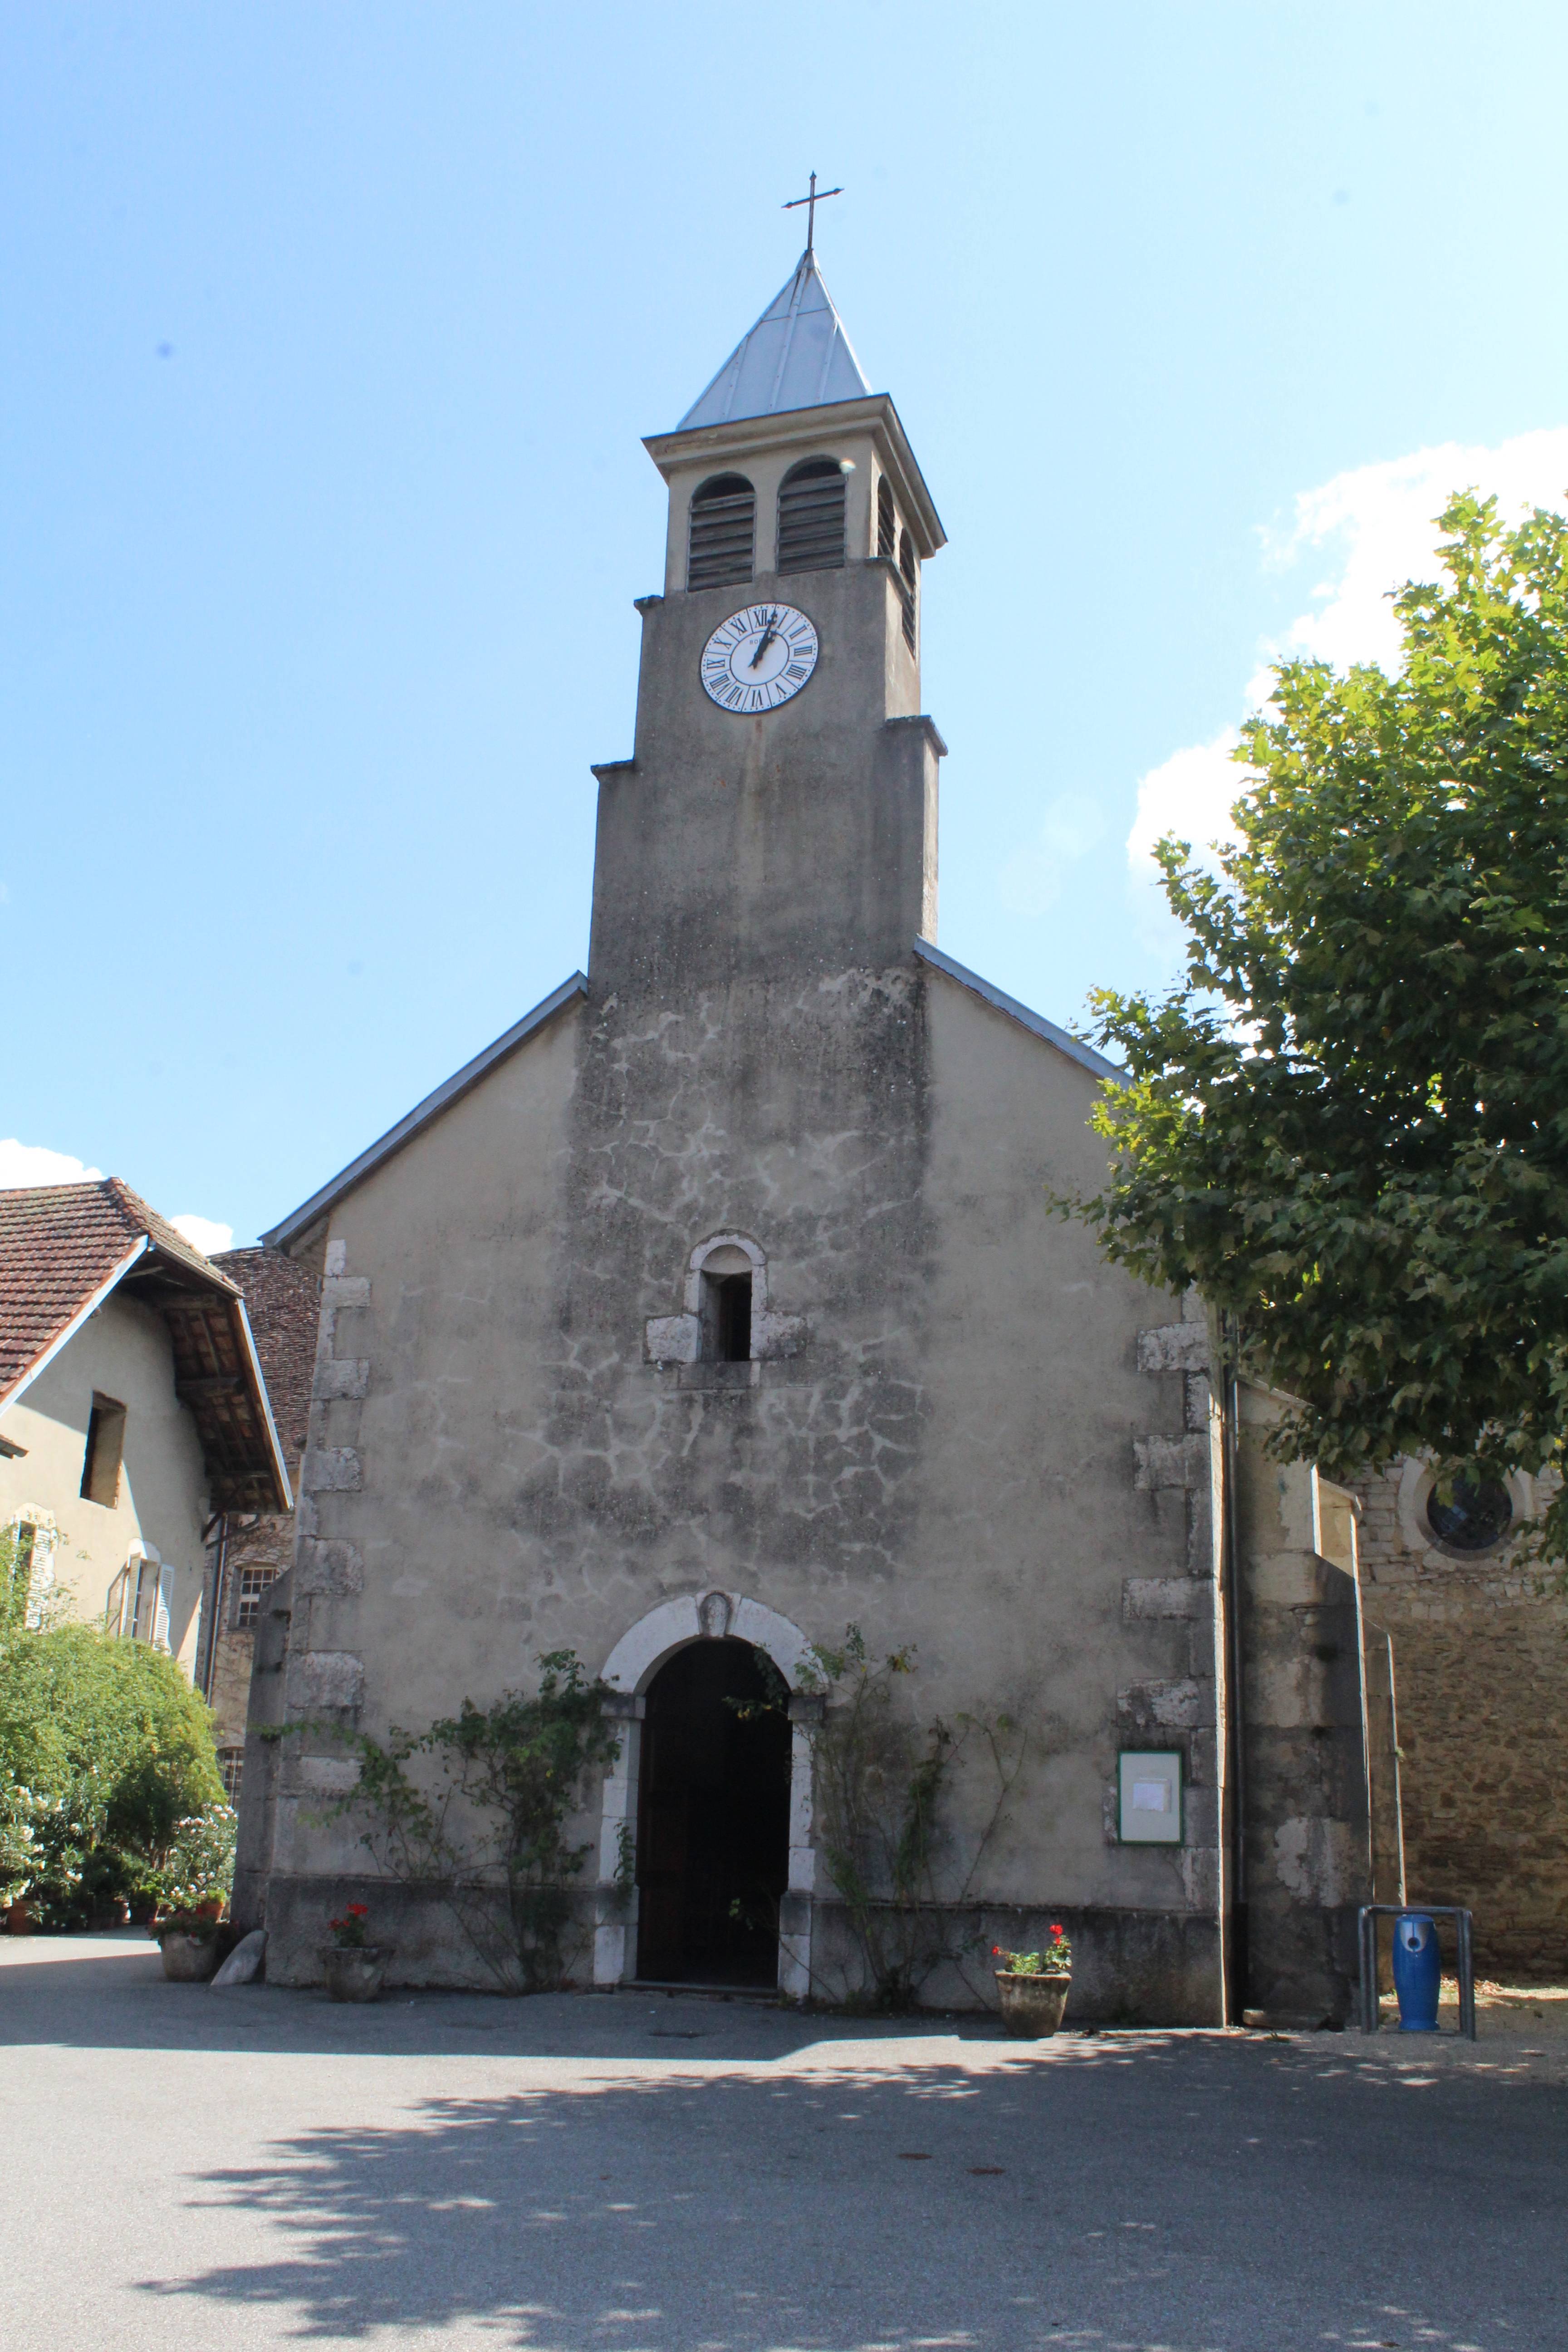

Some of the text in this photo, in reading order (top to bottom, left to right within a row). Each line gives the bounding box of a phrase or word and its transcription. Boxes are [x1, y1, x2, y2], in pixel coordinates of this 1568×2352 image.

[753, 609, 767, 627] XII
[777, 611, 788, 629] I
[730, 618, 747, 636] XI
[789, 624, 807, 640] II
[714, 637, 732, 649] X
[794, 646, 813, 656] III
[707, 659, 725, 669] IX
[786, 664, 807, 681] IIII
[710, 673, 731, 696] VIII
[775, 683, 787, 697] V
[725, 686, 743, 706] VII
[751, 690, 763, 706] VI
